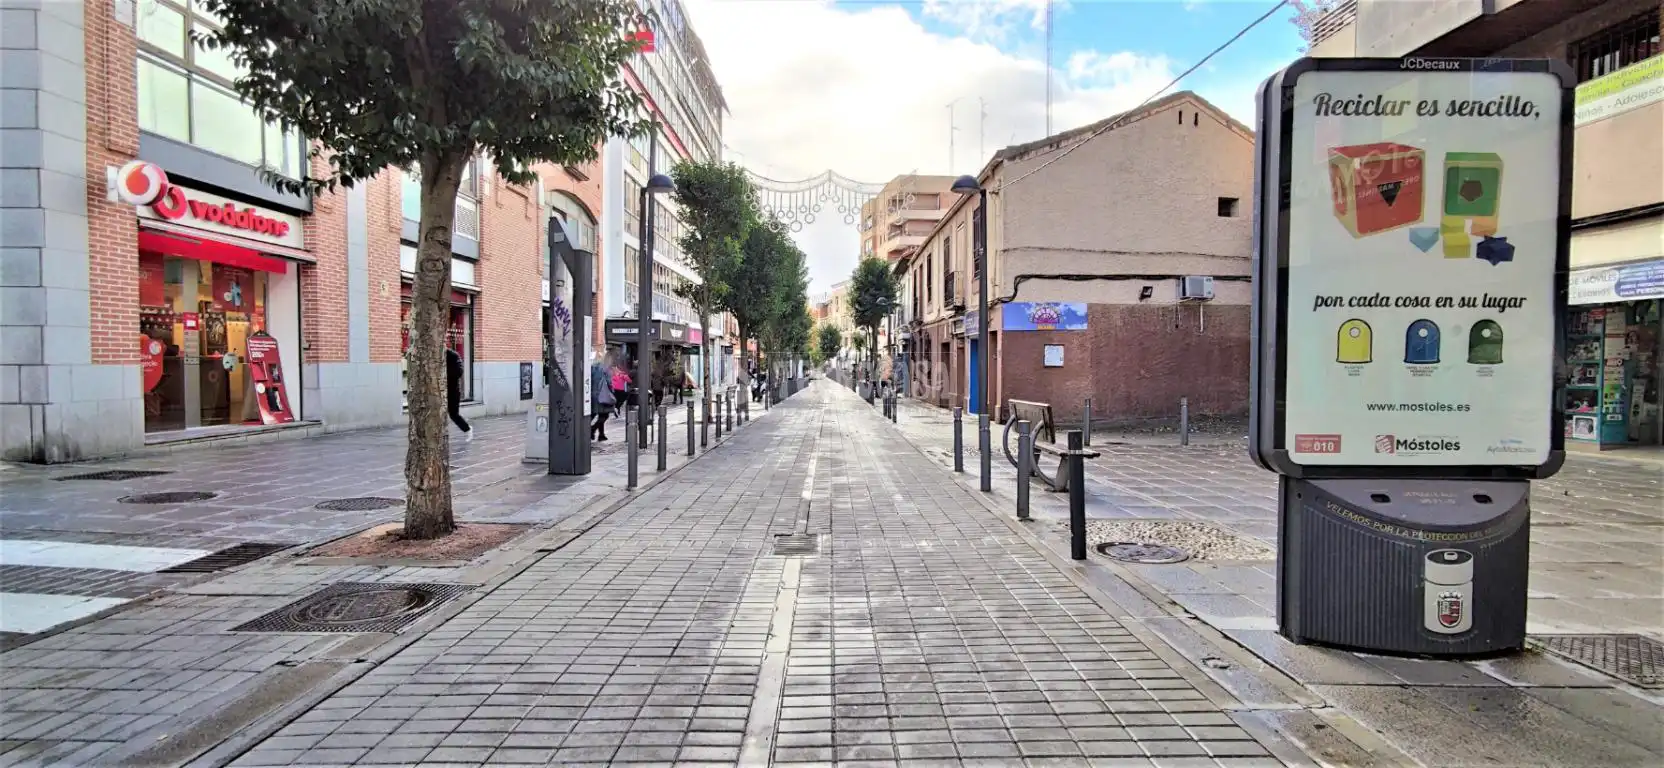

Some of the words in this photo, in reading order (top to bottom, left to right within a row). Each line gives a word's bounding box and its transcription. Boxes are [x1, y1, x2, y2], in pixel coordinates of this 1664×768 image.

[1400, 58, 1460, 70] JCDecaux
[1313, 92, 1412, 117] Reciclar
[1416, 100, 1440, 117] es
[1445, 95, 1540, 120] sencillo,
[188, 200, 290, 238] vodafone
[1313, 295, 1344, 311] pon
[1348, 292, 1391, 309] cada
[1394, 296, 1430, 309] cosa
[1435, 296, 1455, 309] en
[1457, 296, 1479, 309] su
[1481, 293, 1527, 313] lugar
[1367, 401, 1471, 413] www.mostoles.es
[1313, 441, 1335, 451] 010
[1396, 439, 1461, 451] Móstoles
[1327, 501, 1371, 526] VELEMOS
[1373, 521, 1394, 534] POR
[1395, 527, 1410, 538] LA
